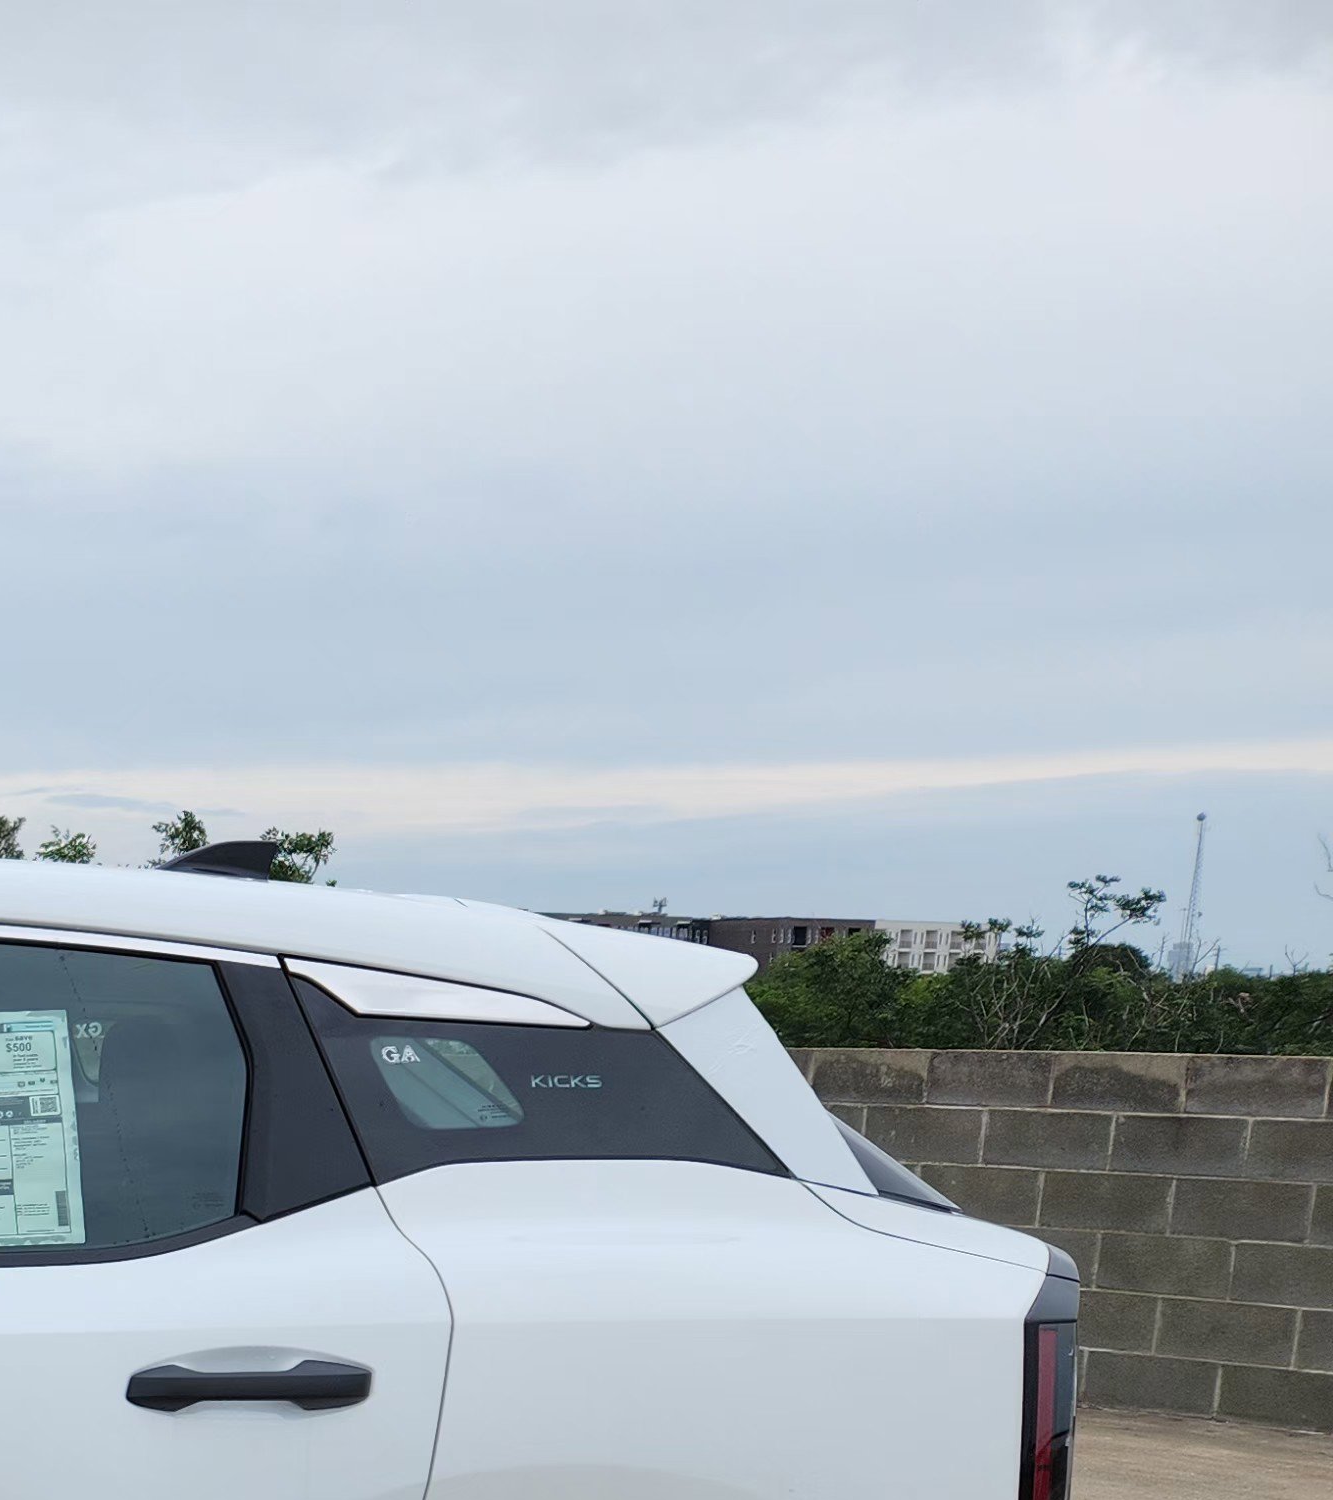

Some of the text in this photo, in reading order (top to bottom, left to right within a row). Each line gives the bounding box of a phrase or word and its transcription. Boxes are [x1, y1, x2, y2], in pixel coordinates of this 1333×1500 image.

[5, 1042, 32, 1053] $500
[381, 1044, 421, 1064] GA
[531, 1075, 603, 1088] KICKS
